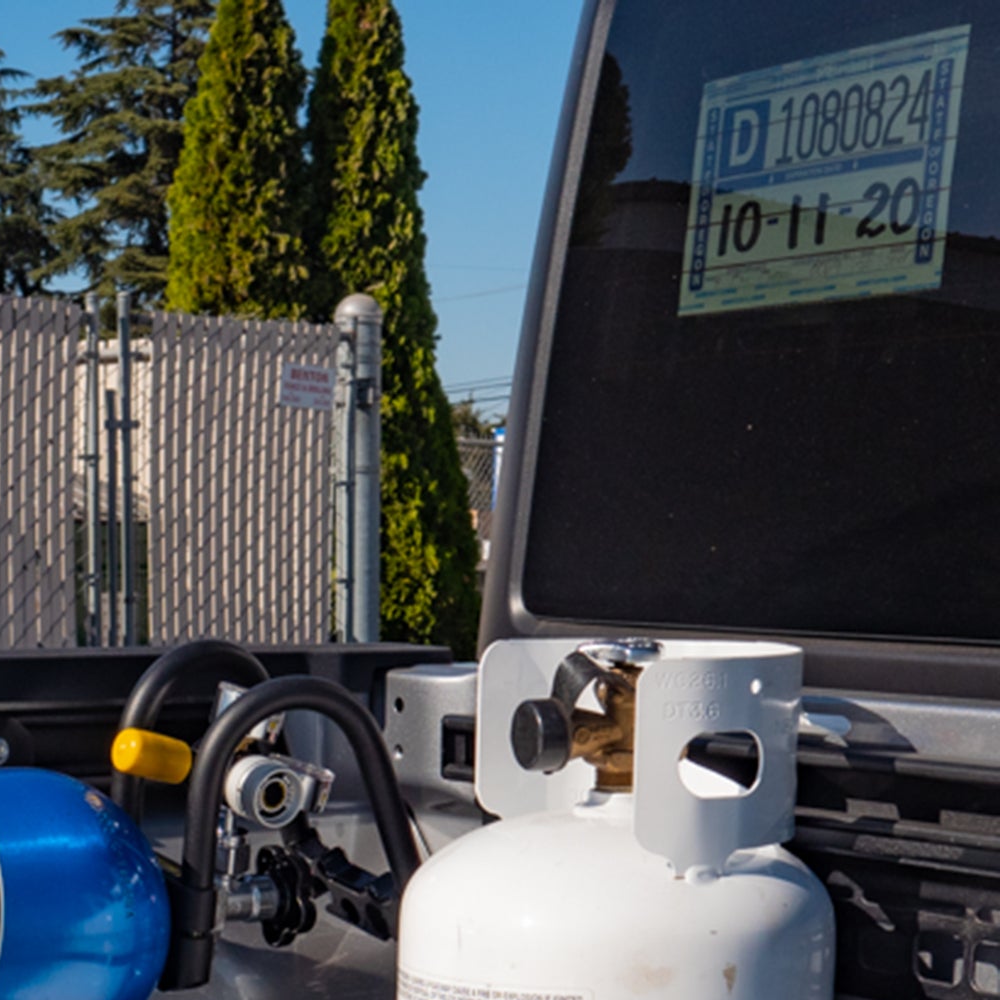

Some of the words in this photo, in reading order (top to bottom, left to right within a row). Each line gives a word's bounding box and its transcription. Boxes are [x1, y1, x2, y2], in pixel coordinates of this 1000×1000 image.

[729, 109, 760, 167] D
[775, 69, 932, 166] 1080824
[717, 177, 921, 256] 10-11-20
[919, 160, 939, 257] OREGON
